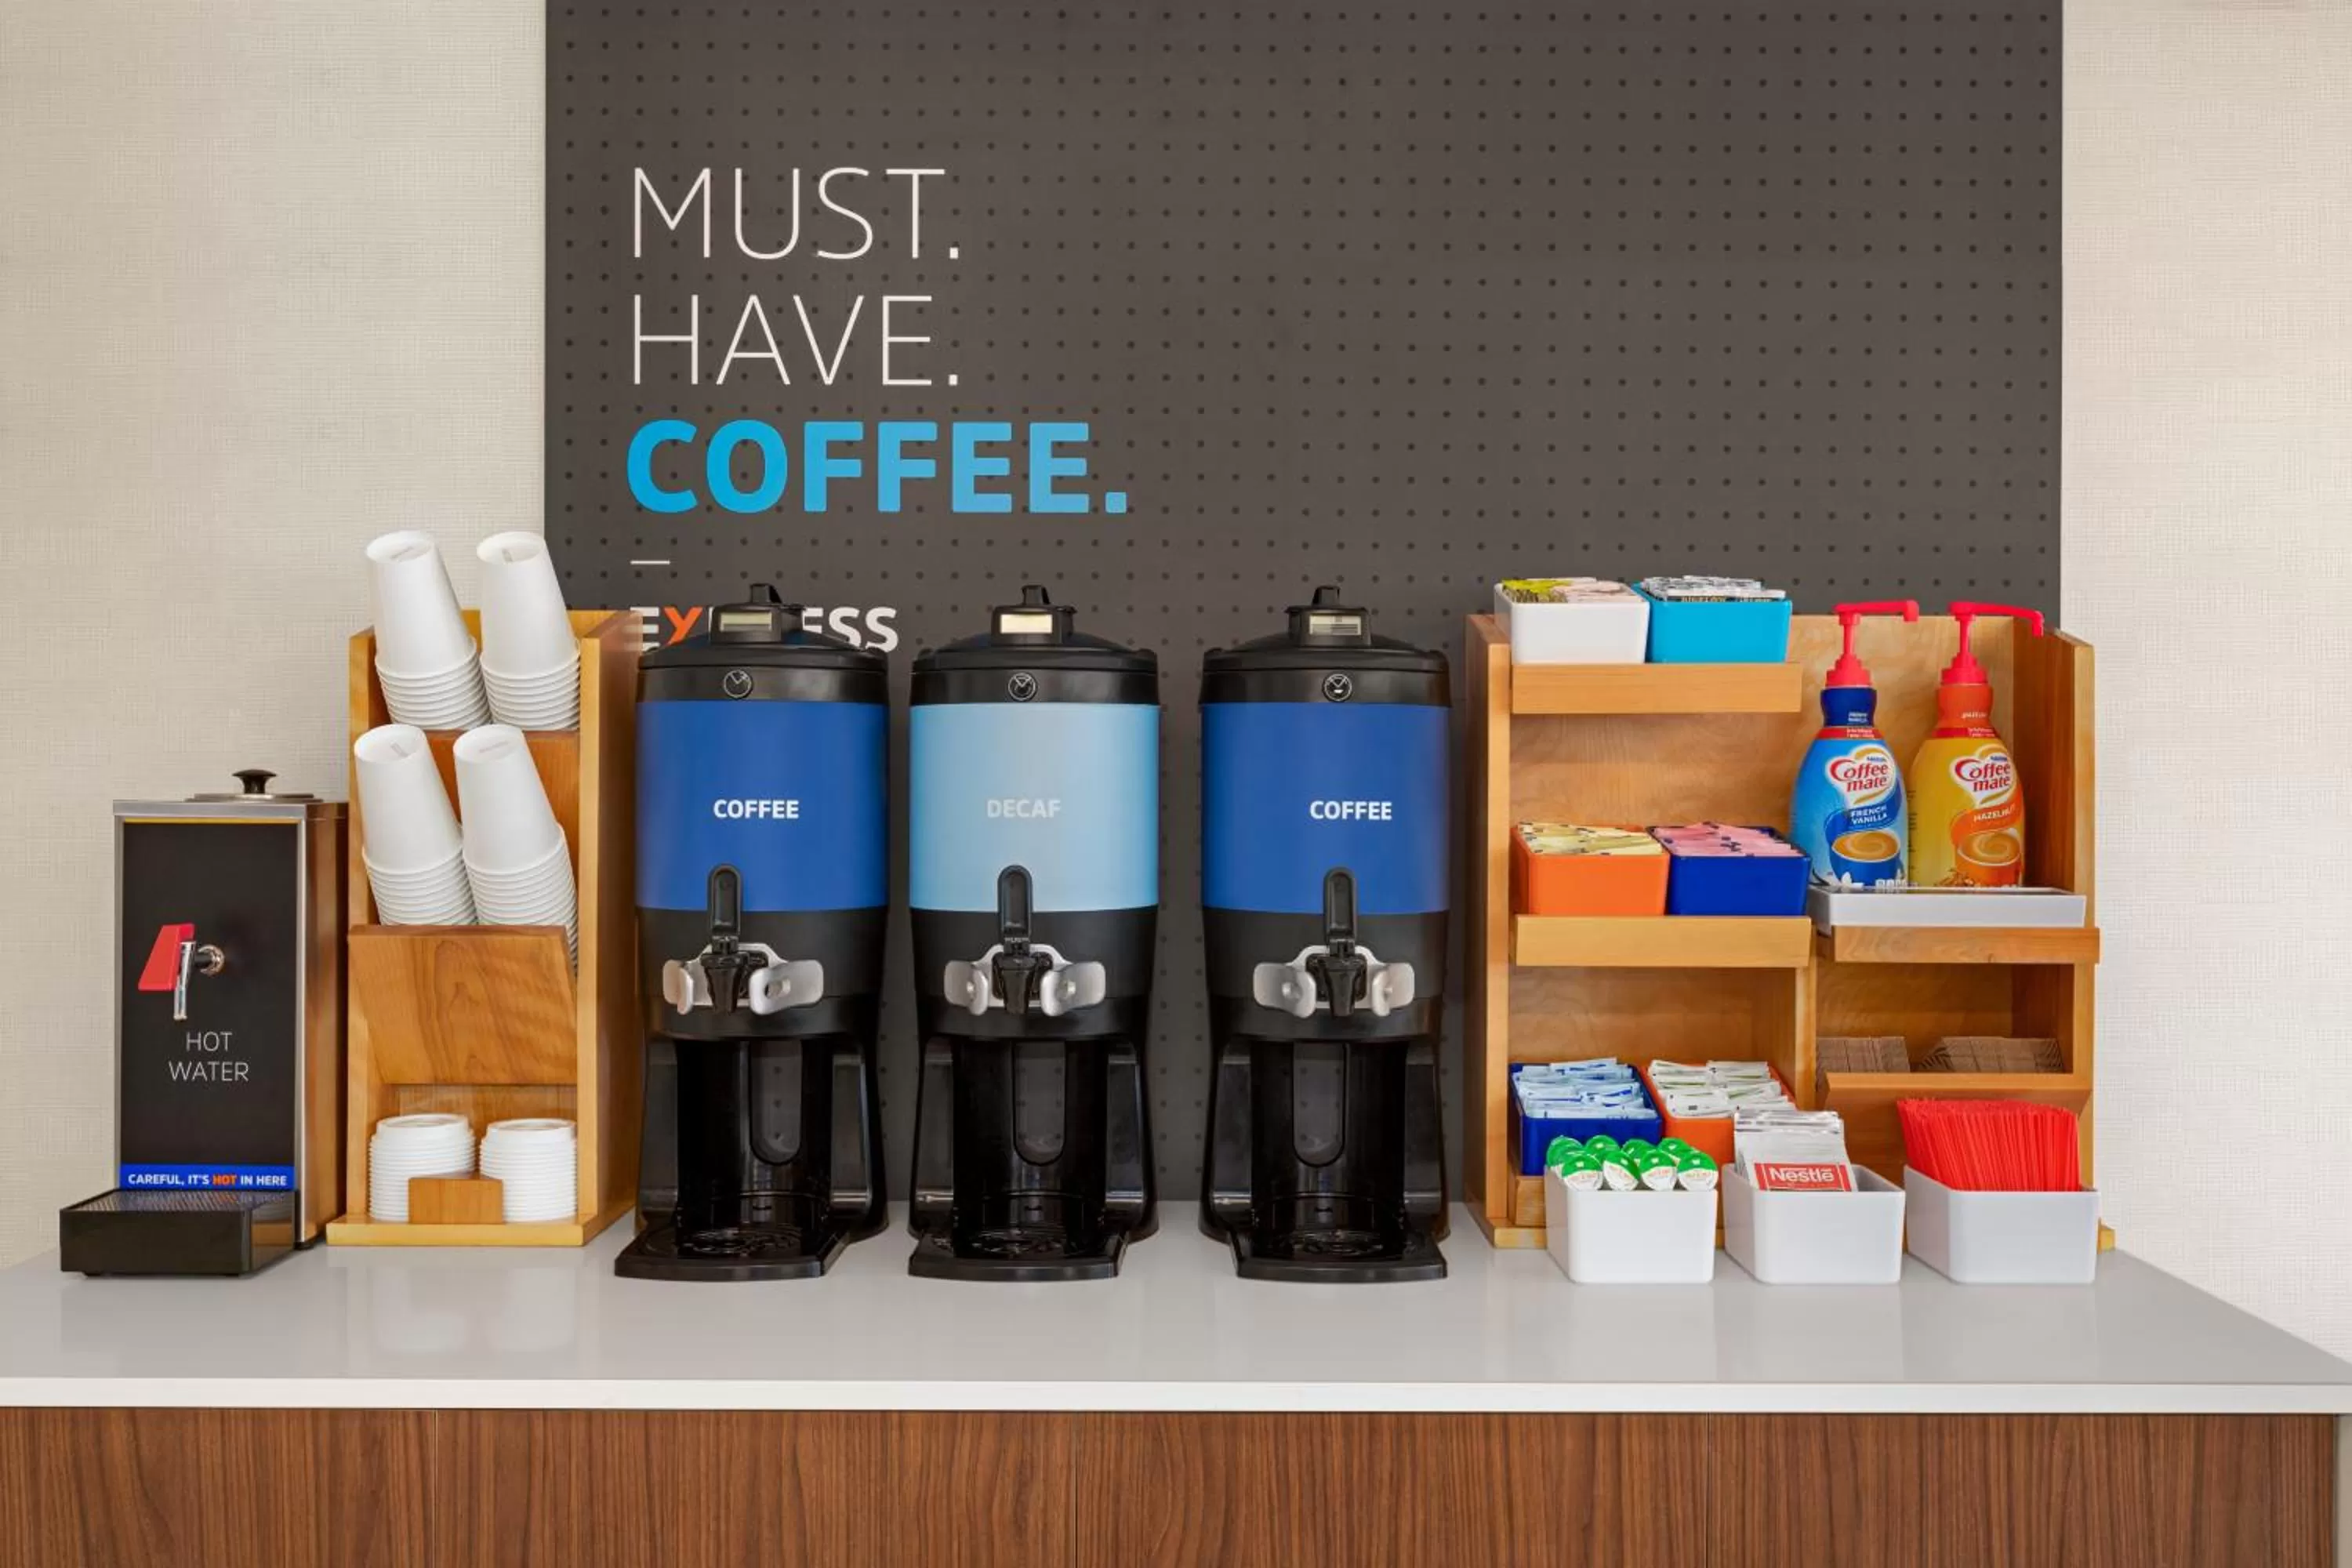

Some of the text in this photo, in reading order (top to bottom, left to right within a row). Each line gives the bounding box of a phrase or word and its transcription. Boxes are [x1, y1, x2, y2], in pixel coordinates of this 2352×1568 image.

[634, 167, 959, 260] MUST.
[634, 294, 958, 386] HAVE.
[626, 419, 1127, 514] COFFEE.
[1830, 758, 1889, 782] Coffee
[1955, 758, 2011, 782] Coffee
[1846, 776, 1888, 793] mate
[1973, 775, 2011, 793] mate
[713, 799, 799, 819] COFFEE
[986, 798, 1062, 818] DECAF
[1309, 800, 1392, 820] COFFEE
[186, 1031, 233, 1051] HOT
[169, 1061, 249, 1082] WATER
[128, 1174, 185, 1185] CAREFUL,
[212, 1174, 237, 1185] HOT
[241, 1175, 252, 1185] IN
[256, 1175, 286, 1186] HERE
